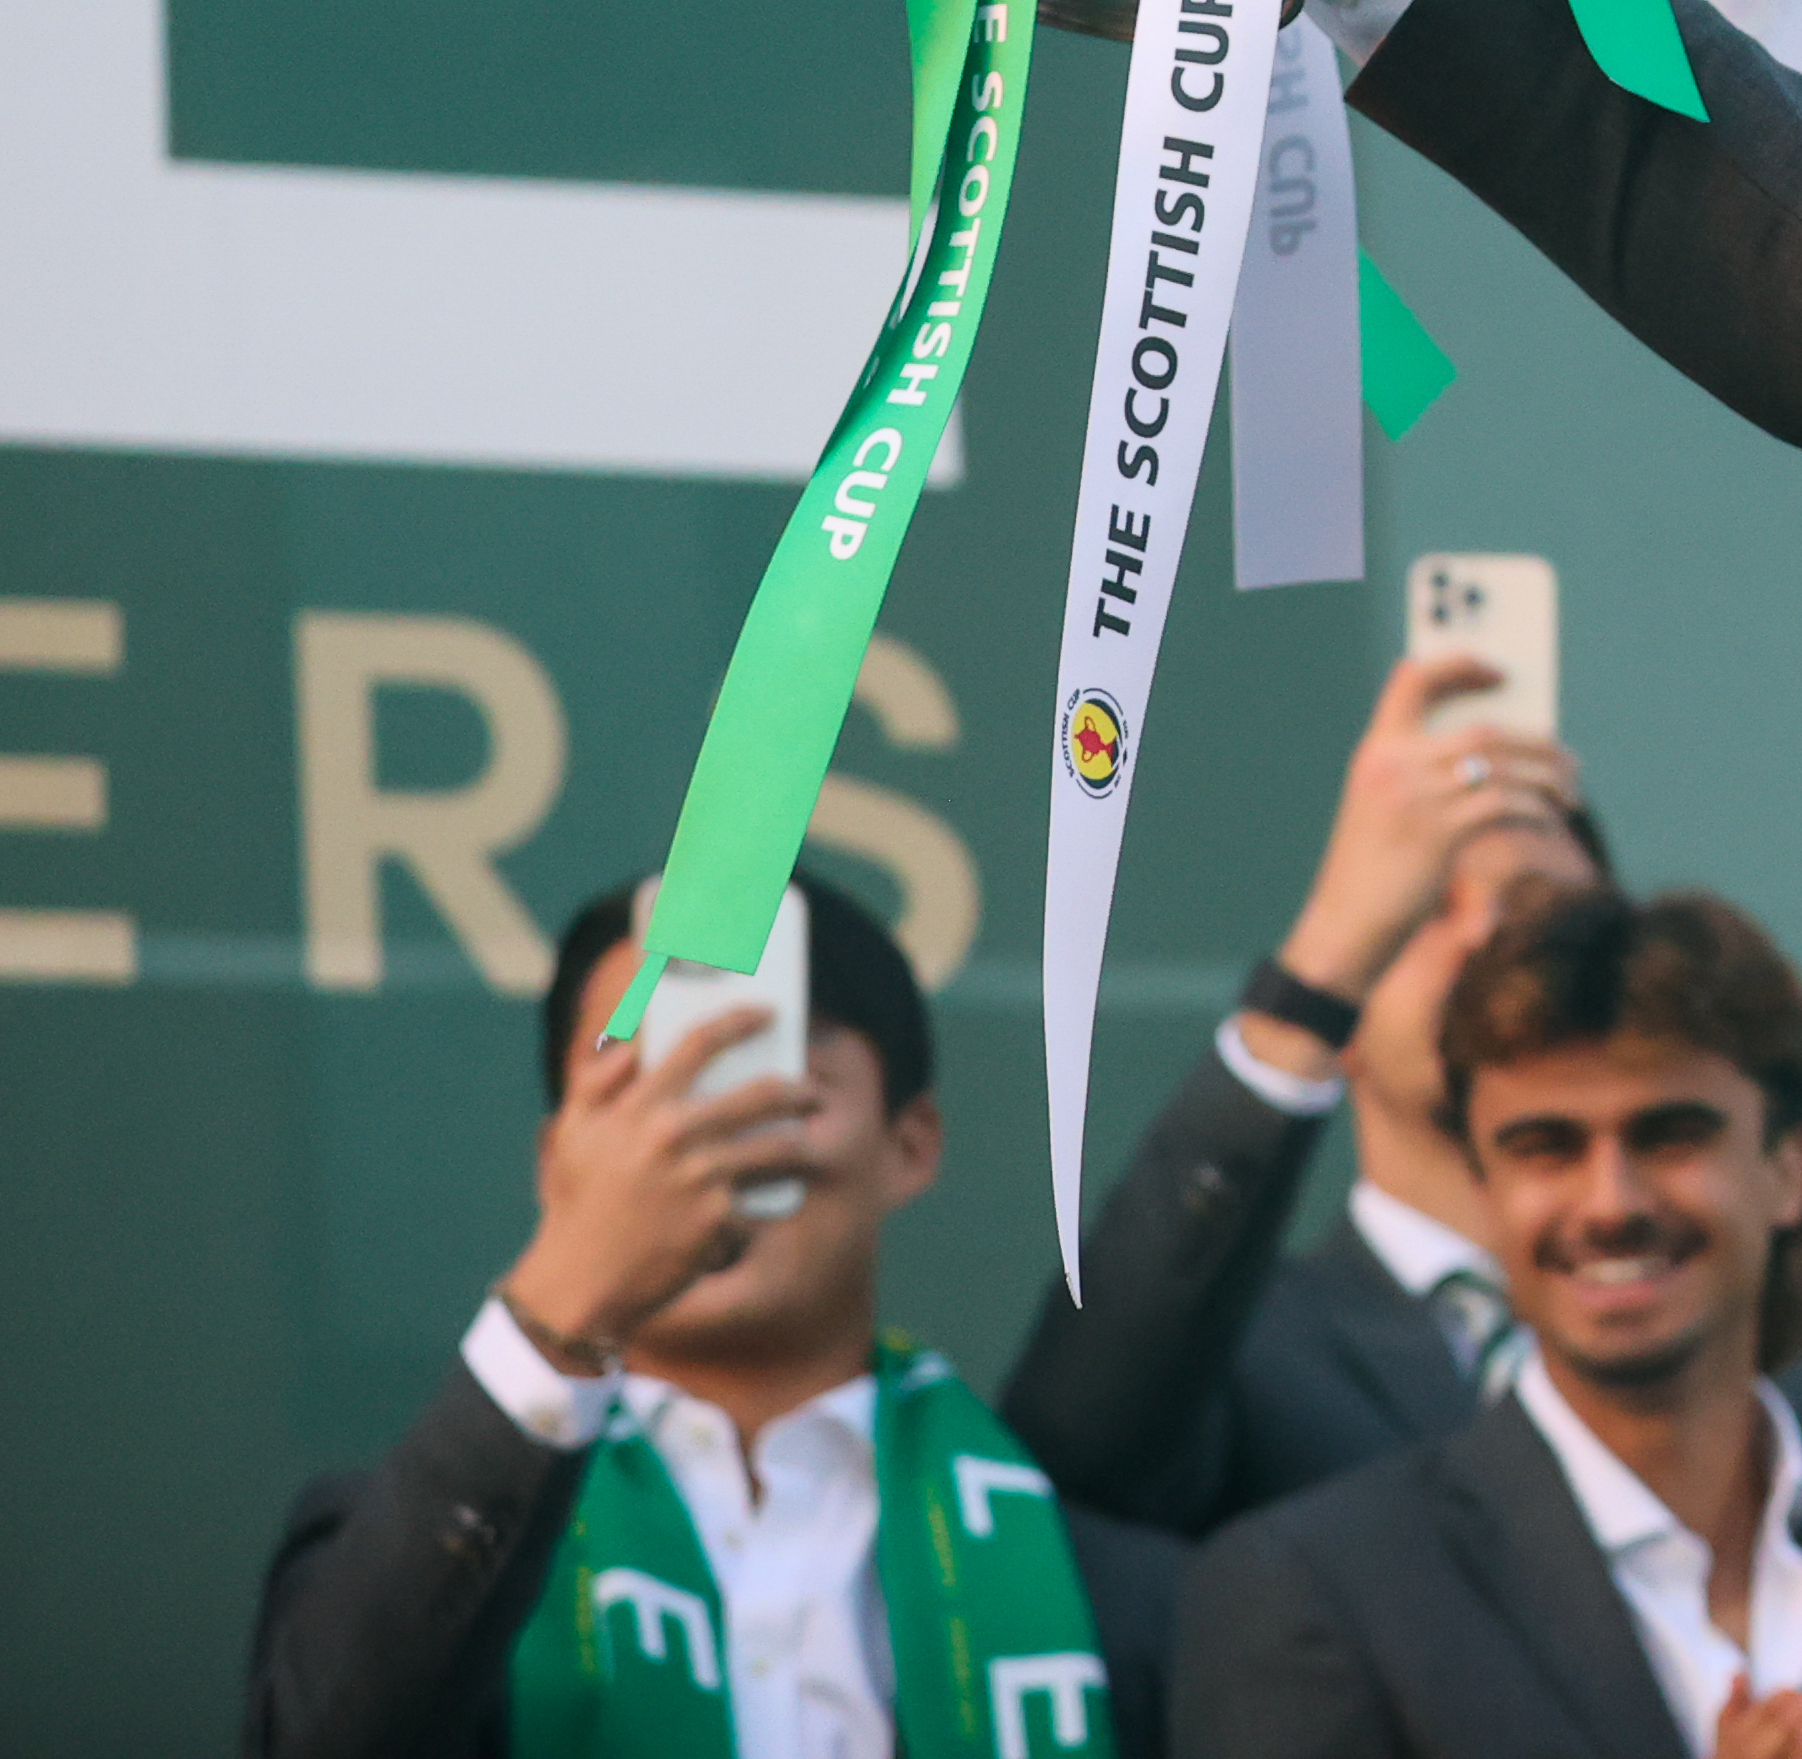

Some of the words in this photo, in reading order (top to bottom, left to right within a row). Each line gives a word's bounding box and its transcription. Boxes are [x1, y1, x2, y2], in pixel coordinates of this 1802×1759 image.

[886, 71, 1004, 407] SCOTTISH
[1117, 136, 1215, 487] SCOTTISH
[821, 428, 904, 561] CUP
[1092, 504, 1151, 639] THE
